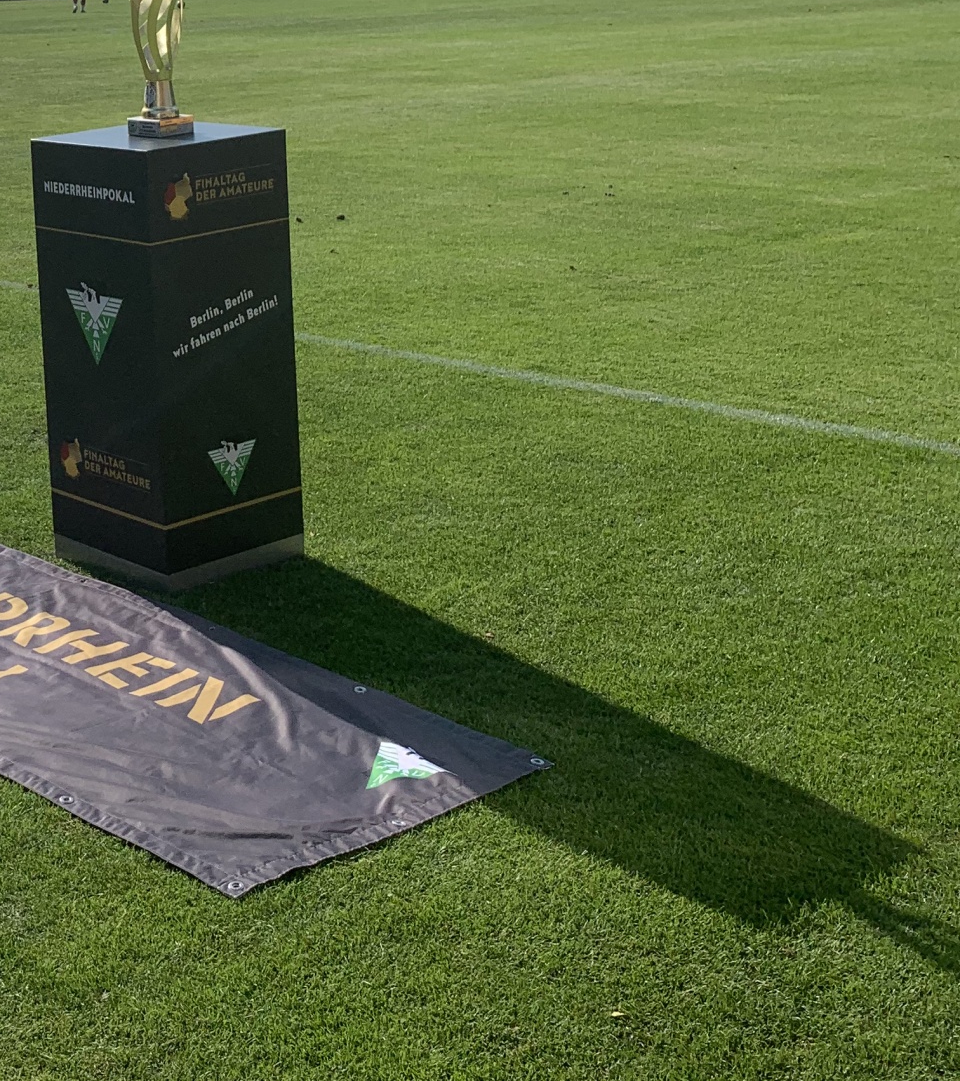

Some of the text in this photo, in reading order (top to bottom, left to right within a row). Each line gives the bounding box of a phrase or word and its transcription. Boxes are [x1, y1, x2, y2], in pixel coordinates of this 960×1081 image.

[43, 180, 136, 204] NIEDERRHEINPOKAL
[195, 172, 246, 190] FINALTAG
[196, 179, 274, 202] DER AMATEURE
[189, 289, 254, 329] Berlin, Berlin
[172, 294, 279, 358] wir fahren nach Berlin!
[83, 449, 126, 471] FINALTAG
[84, 460, 151, 490] DER AMATEURE
